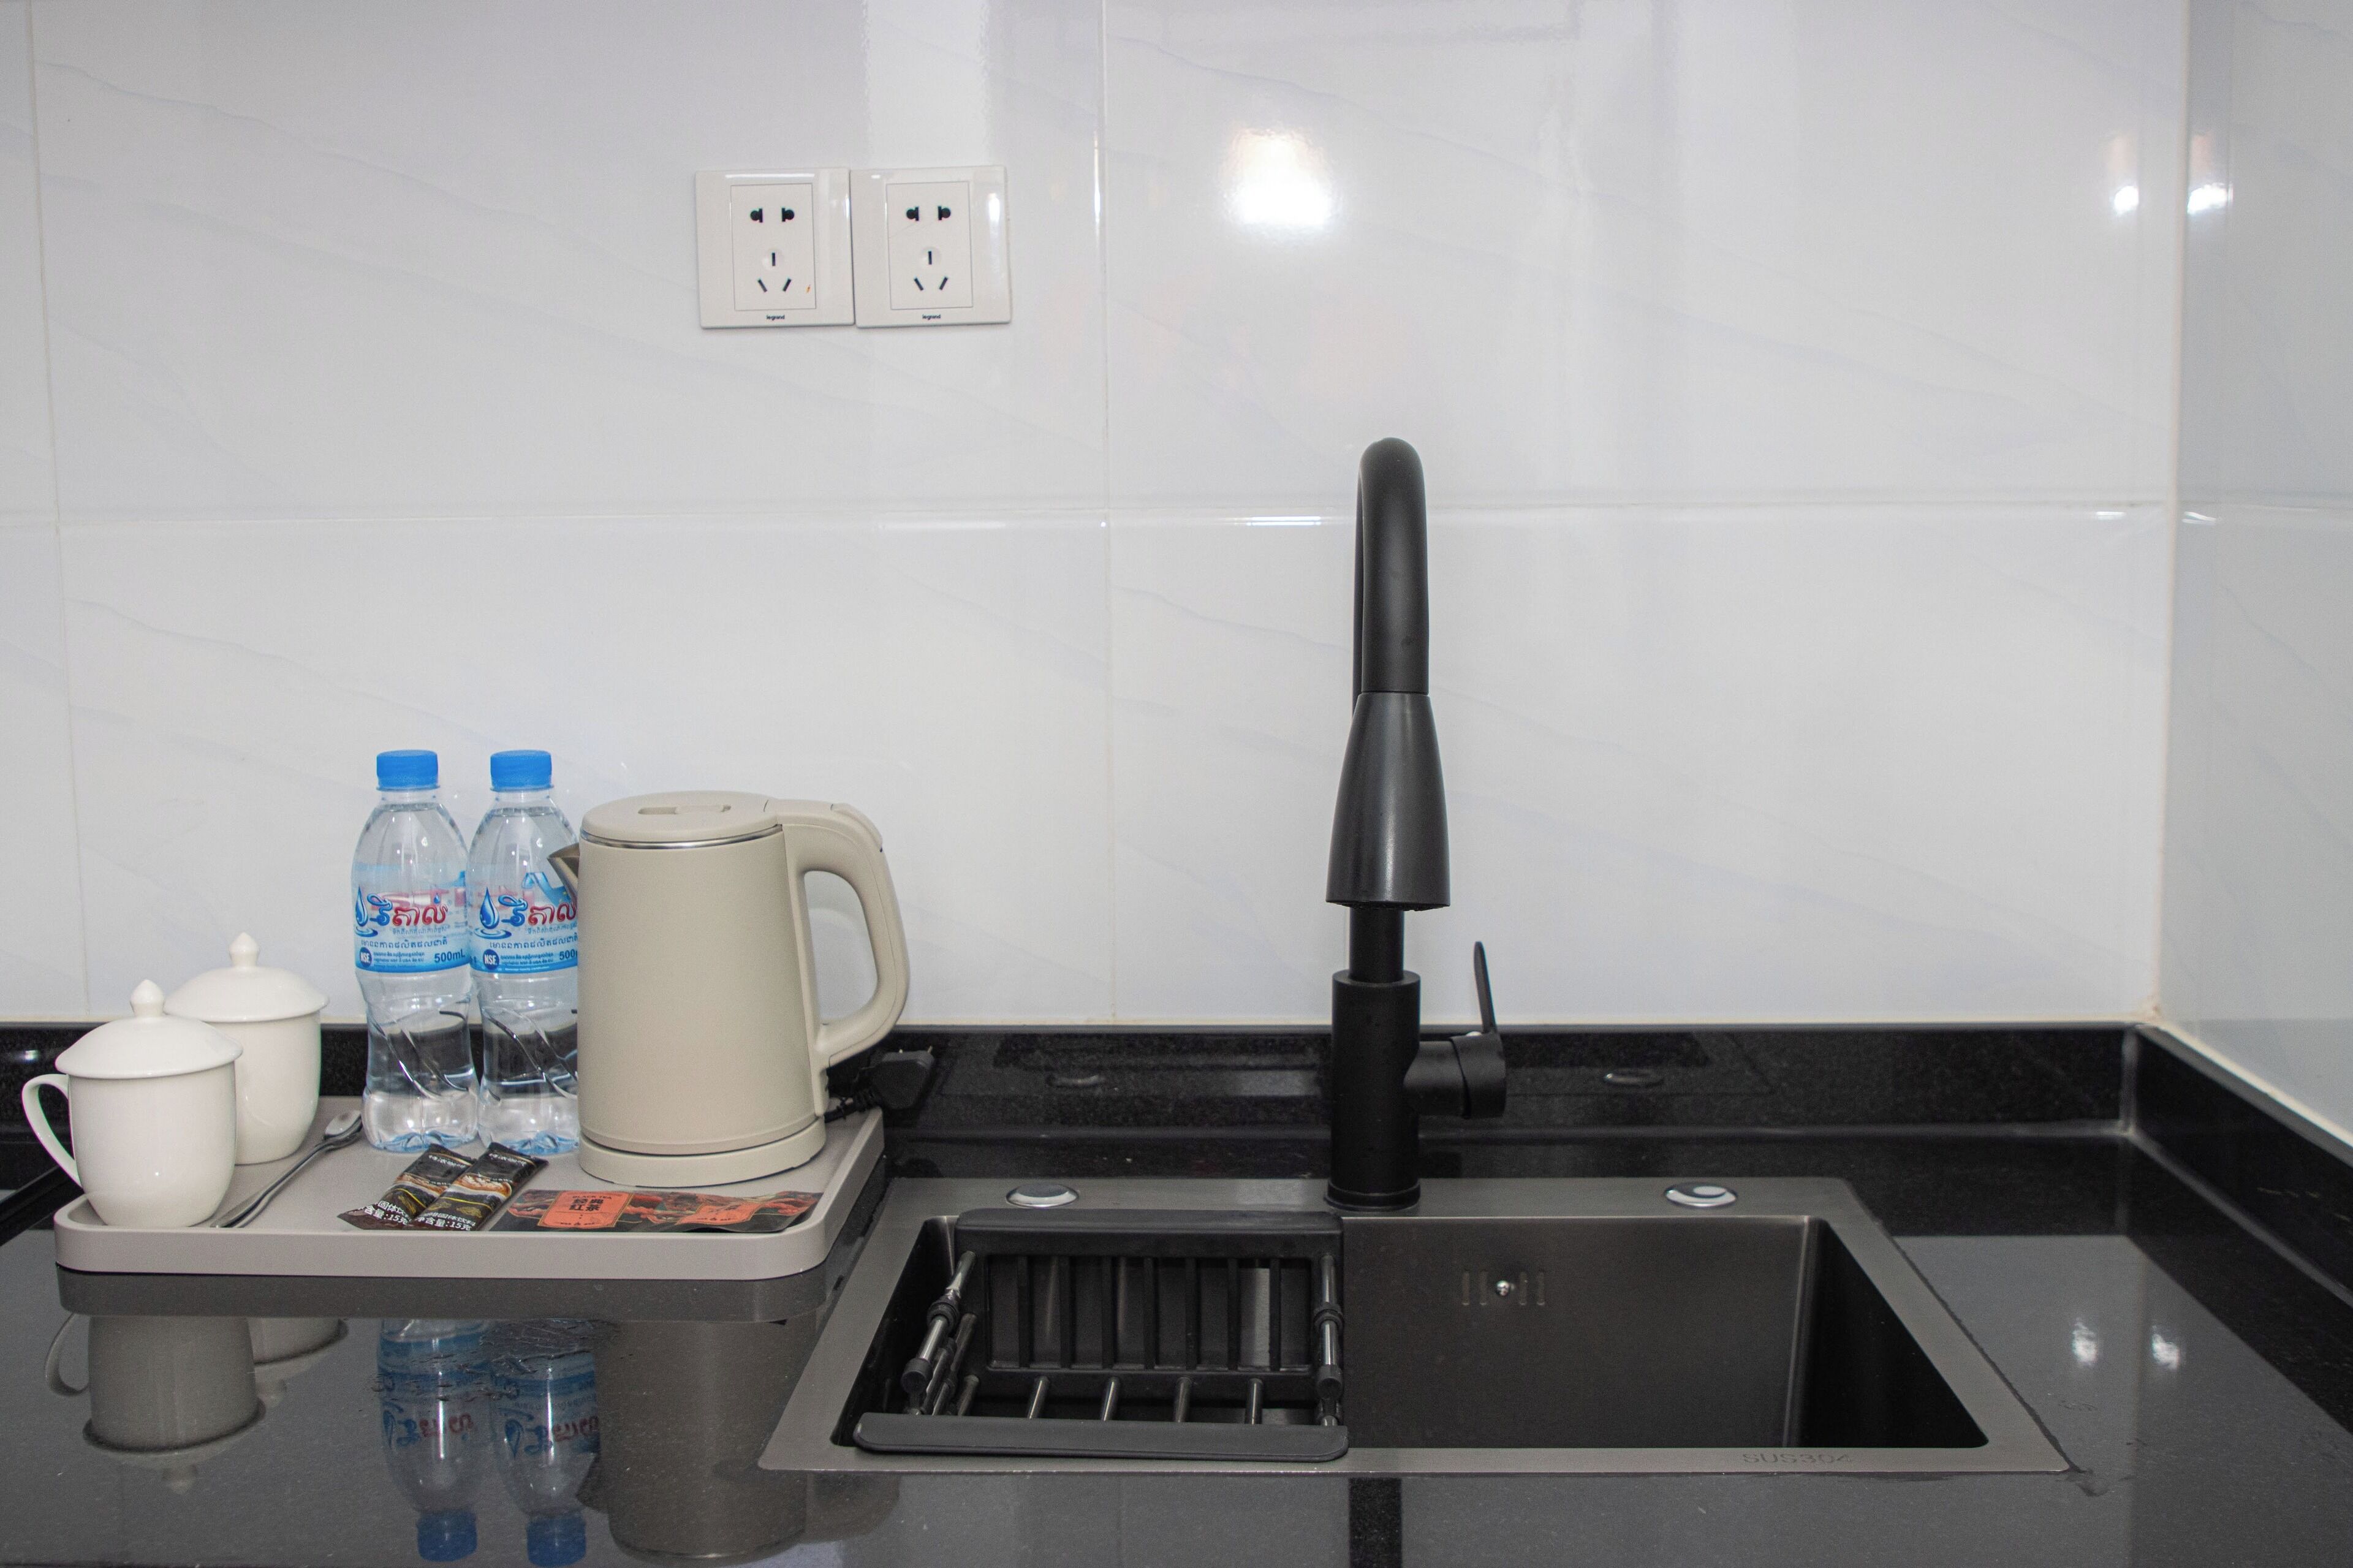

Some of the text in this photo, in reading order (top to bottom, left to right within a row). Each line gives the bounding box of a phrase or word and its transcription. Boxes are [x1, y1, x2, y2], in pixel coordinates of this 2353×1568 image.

[434, 949, 466, 963] 500mL
[484, 955, 497, 965] NSF
[559, 949, 577, 960] 500
[364, 1205, 408, 1225] 含量:15克
